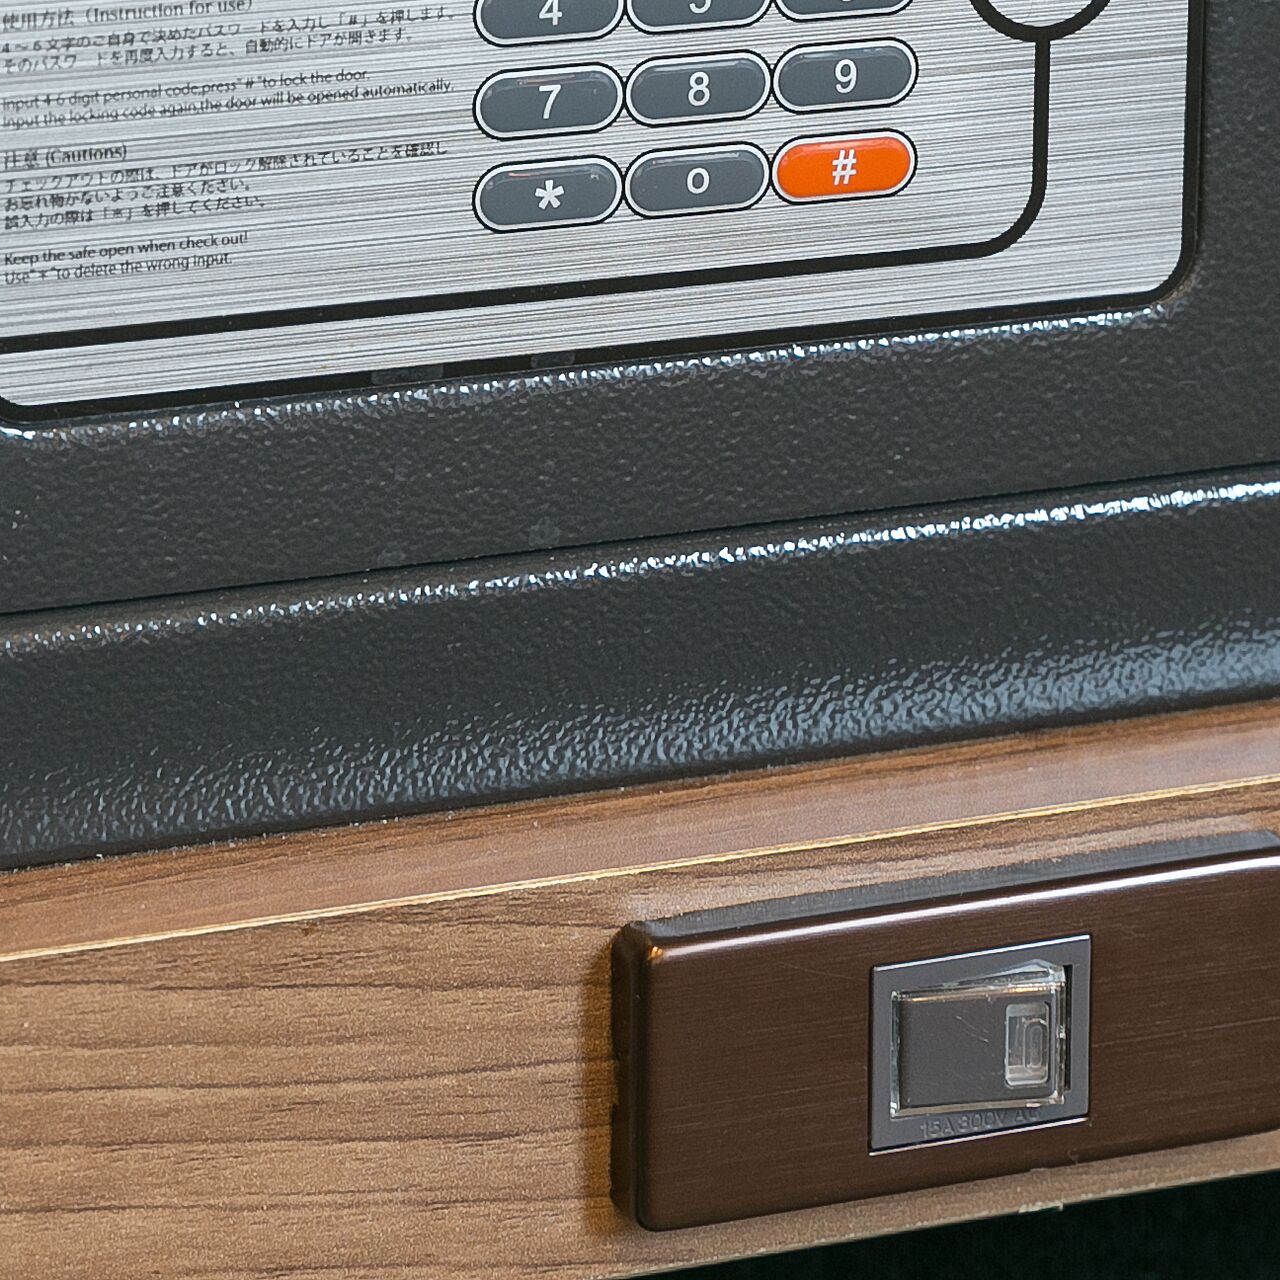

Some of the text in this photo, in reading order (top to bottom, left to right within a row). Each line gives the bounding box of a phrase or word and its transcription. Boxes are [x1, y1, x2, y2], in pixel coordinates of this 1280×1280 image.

[189, 0, 213, 16] for
[43, 112, 65, 125] the
[69, 107, 118, 123] locking
[121, 103, 152, 118] code
[226, 95, 257, 109] door
[261, 91, 283, 106] will
[287, 90, 304, 104] be
[307, 85, 358, 104] opened
[362, 78, 454, 98] automatically.
[68, 90, 99, 108] digit
[103, 83, 161, 106] personal
[280, 72, 307, 86] lock
[310, 70, 332, 85] the
[335, 69, 370, 82] door.
[539, 59, 856, 119] 7 8 9
[46, 145, 127, 167] (Cautions)
[4, 230, 248, 266] Keep the safe open when check out!
[74, 263, 116, 279] delete
[120, 260, 143, 274] the
[146, 256, 189, 271] wrong
[920, 1116, 955, 1138] 15A
[958, 1109, 1007, 1132] 300V
